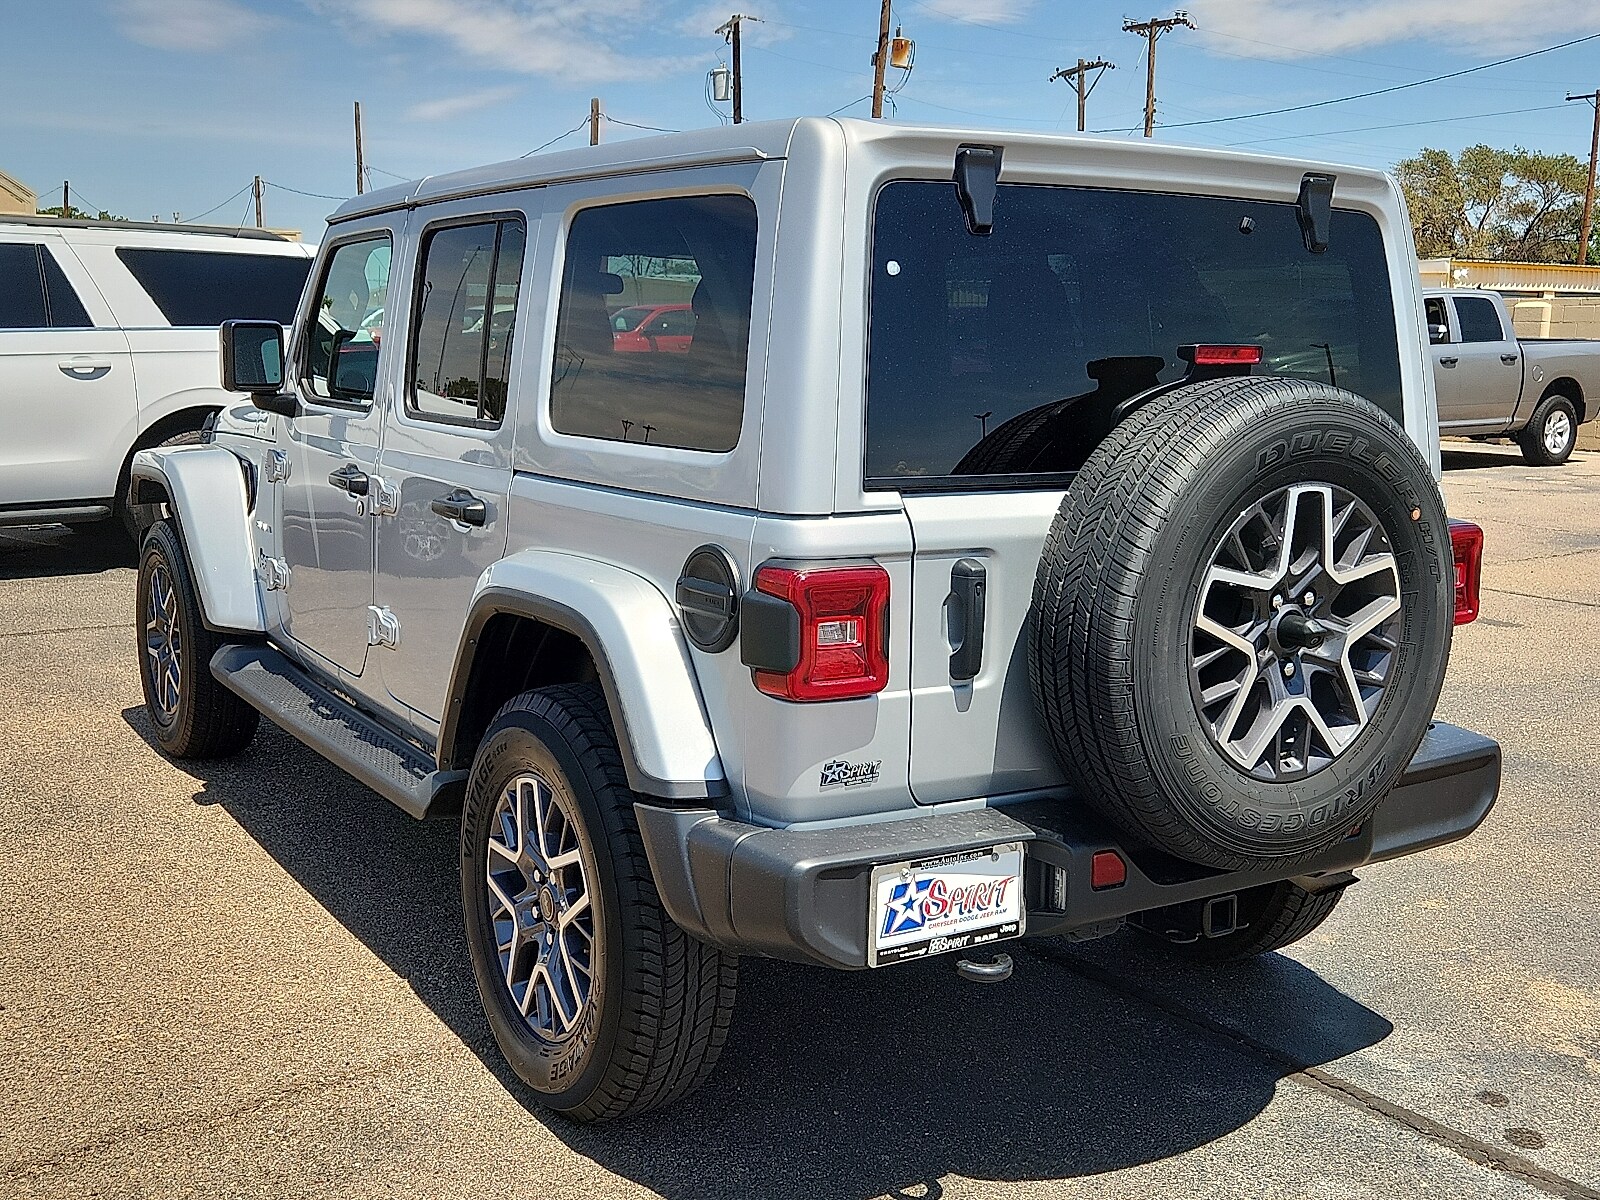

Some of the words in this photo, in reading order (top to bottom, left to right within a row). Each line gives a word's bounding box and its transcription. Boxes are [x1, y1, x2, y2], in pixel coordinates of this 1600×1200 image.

[1254, 429, 1421, 513] DUELER
[1418, 520, 1441, 584] H/T
[841, 760, 882, 779] SPIRIT
[1170, 733, 1388, 834] BRIDGESTONE
[924, 875, 1017, 920] SPIRIT
[928, 919, 958, 930] CHRYSLER
[958, 913, 979, 923] DODGE
[979, 908, 995, 919] JEEP
[994, 907, 1008, 916] RAM
[999, 923, 1018, 934] Jeep
